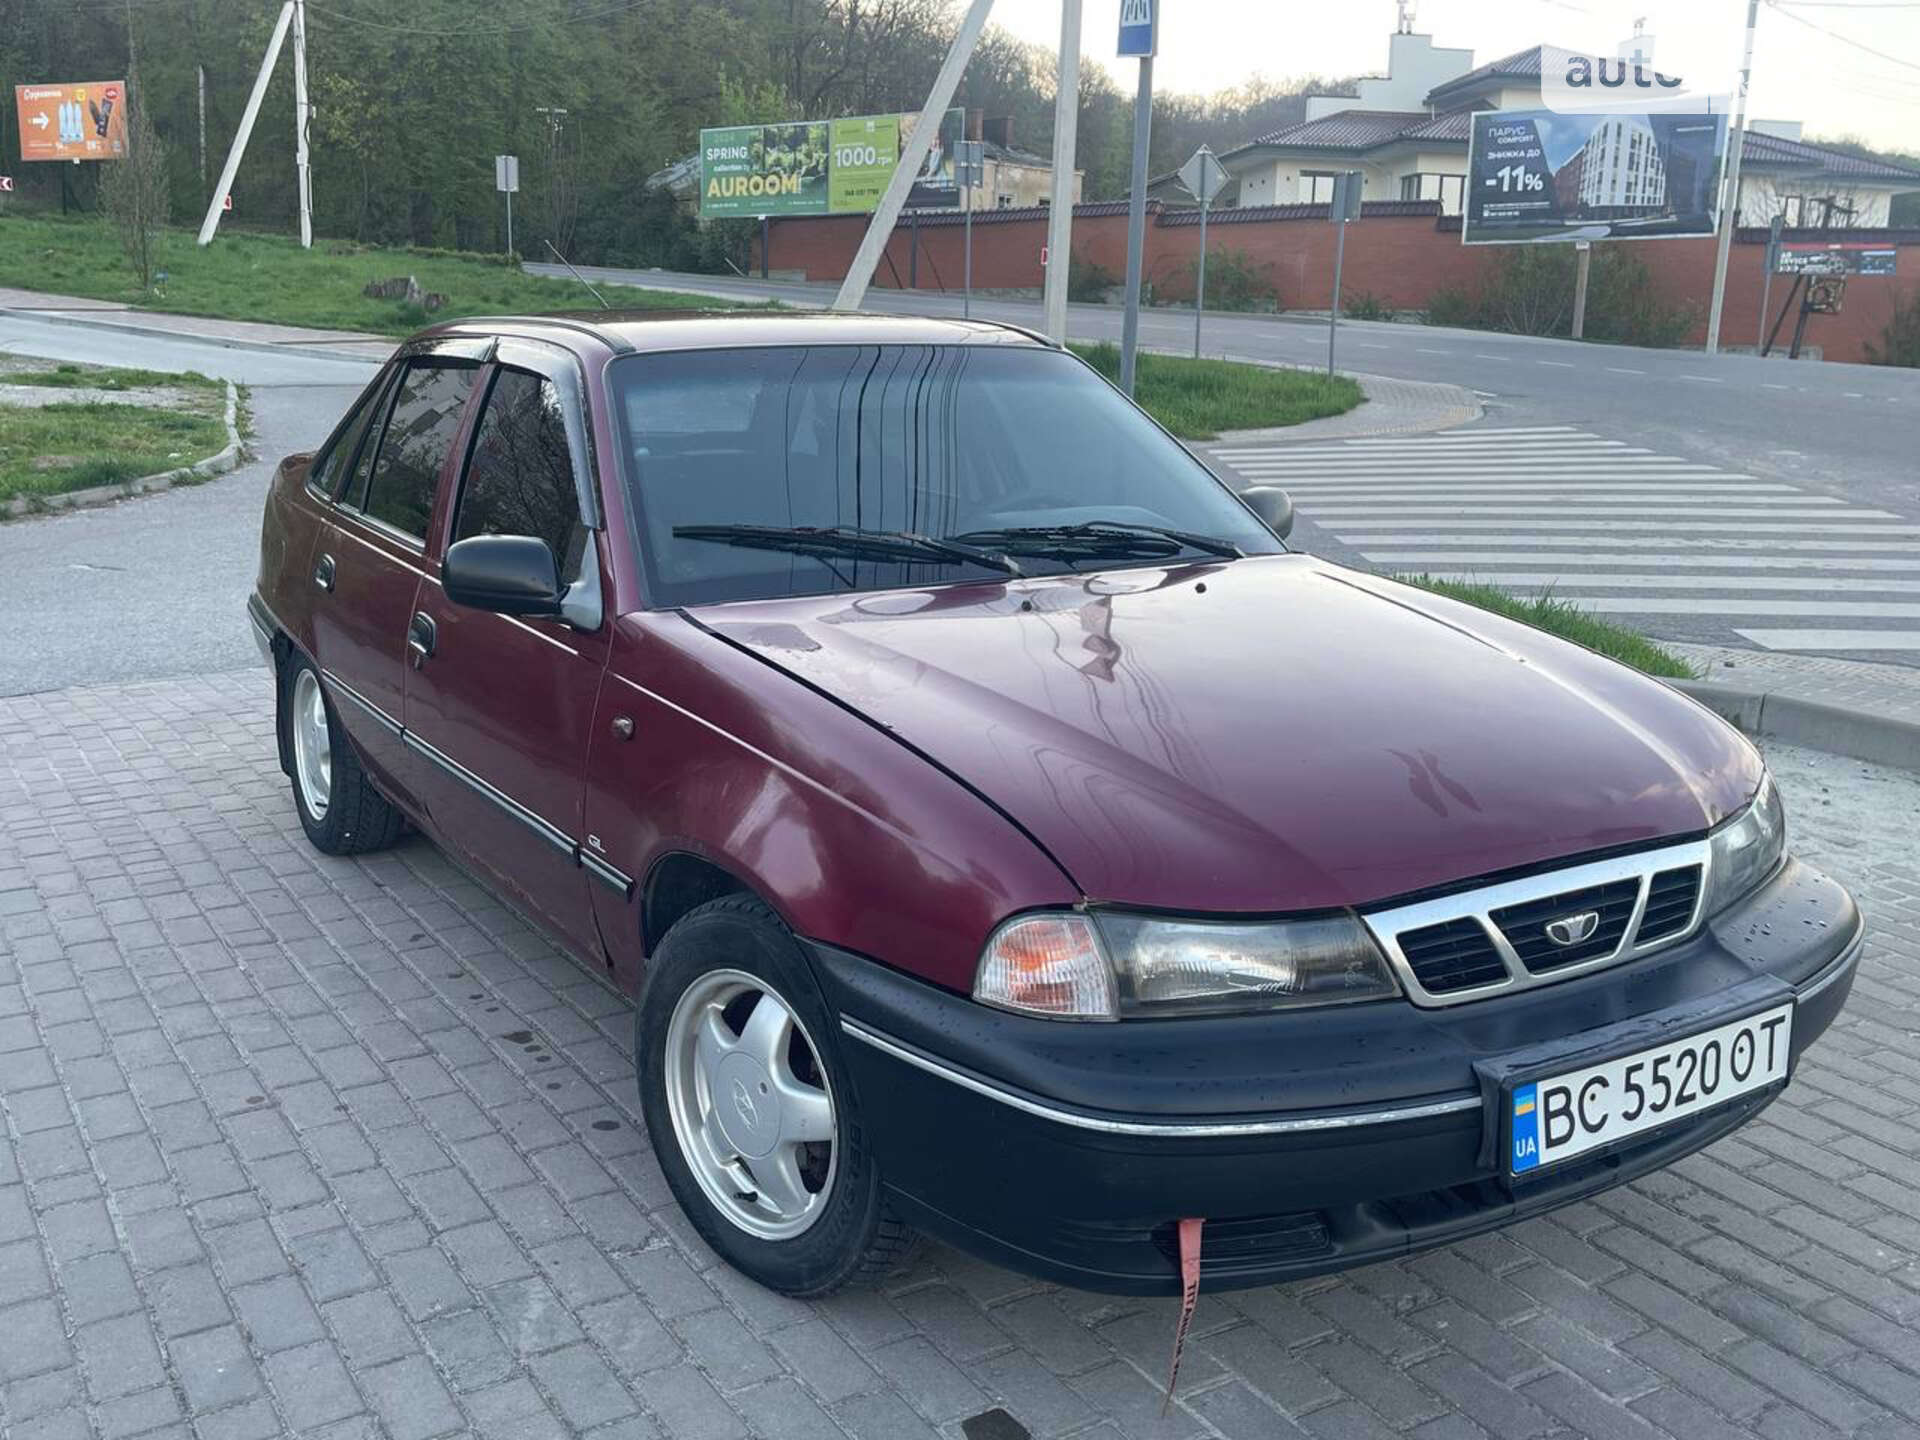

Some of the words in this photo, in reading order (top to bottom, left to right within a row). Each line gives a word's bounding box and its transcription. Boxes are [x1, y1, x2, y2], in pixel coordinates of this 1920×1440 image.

[1489, 126, 1526, 137] ПАРУС
[706, 147, 748, 160] SPRING
[834, 147, 876, 168] 1000
[707, 174, 801, 198] AUROOM
[1485, 164, 1544, 193] -11%
[1542, 1075, 1610, 1150] BC
[1621, 1039, 1722, 1121] 5520
[1730, 1014, 1787, 1083] OT
[1515, 1137, 1537, 1158] UA
